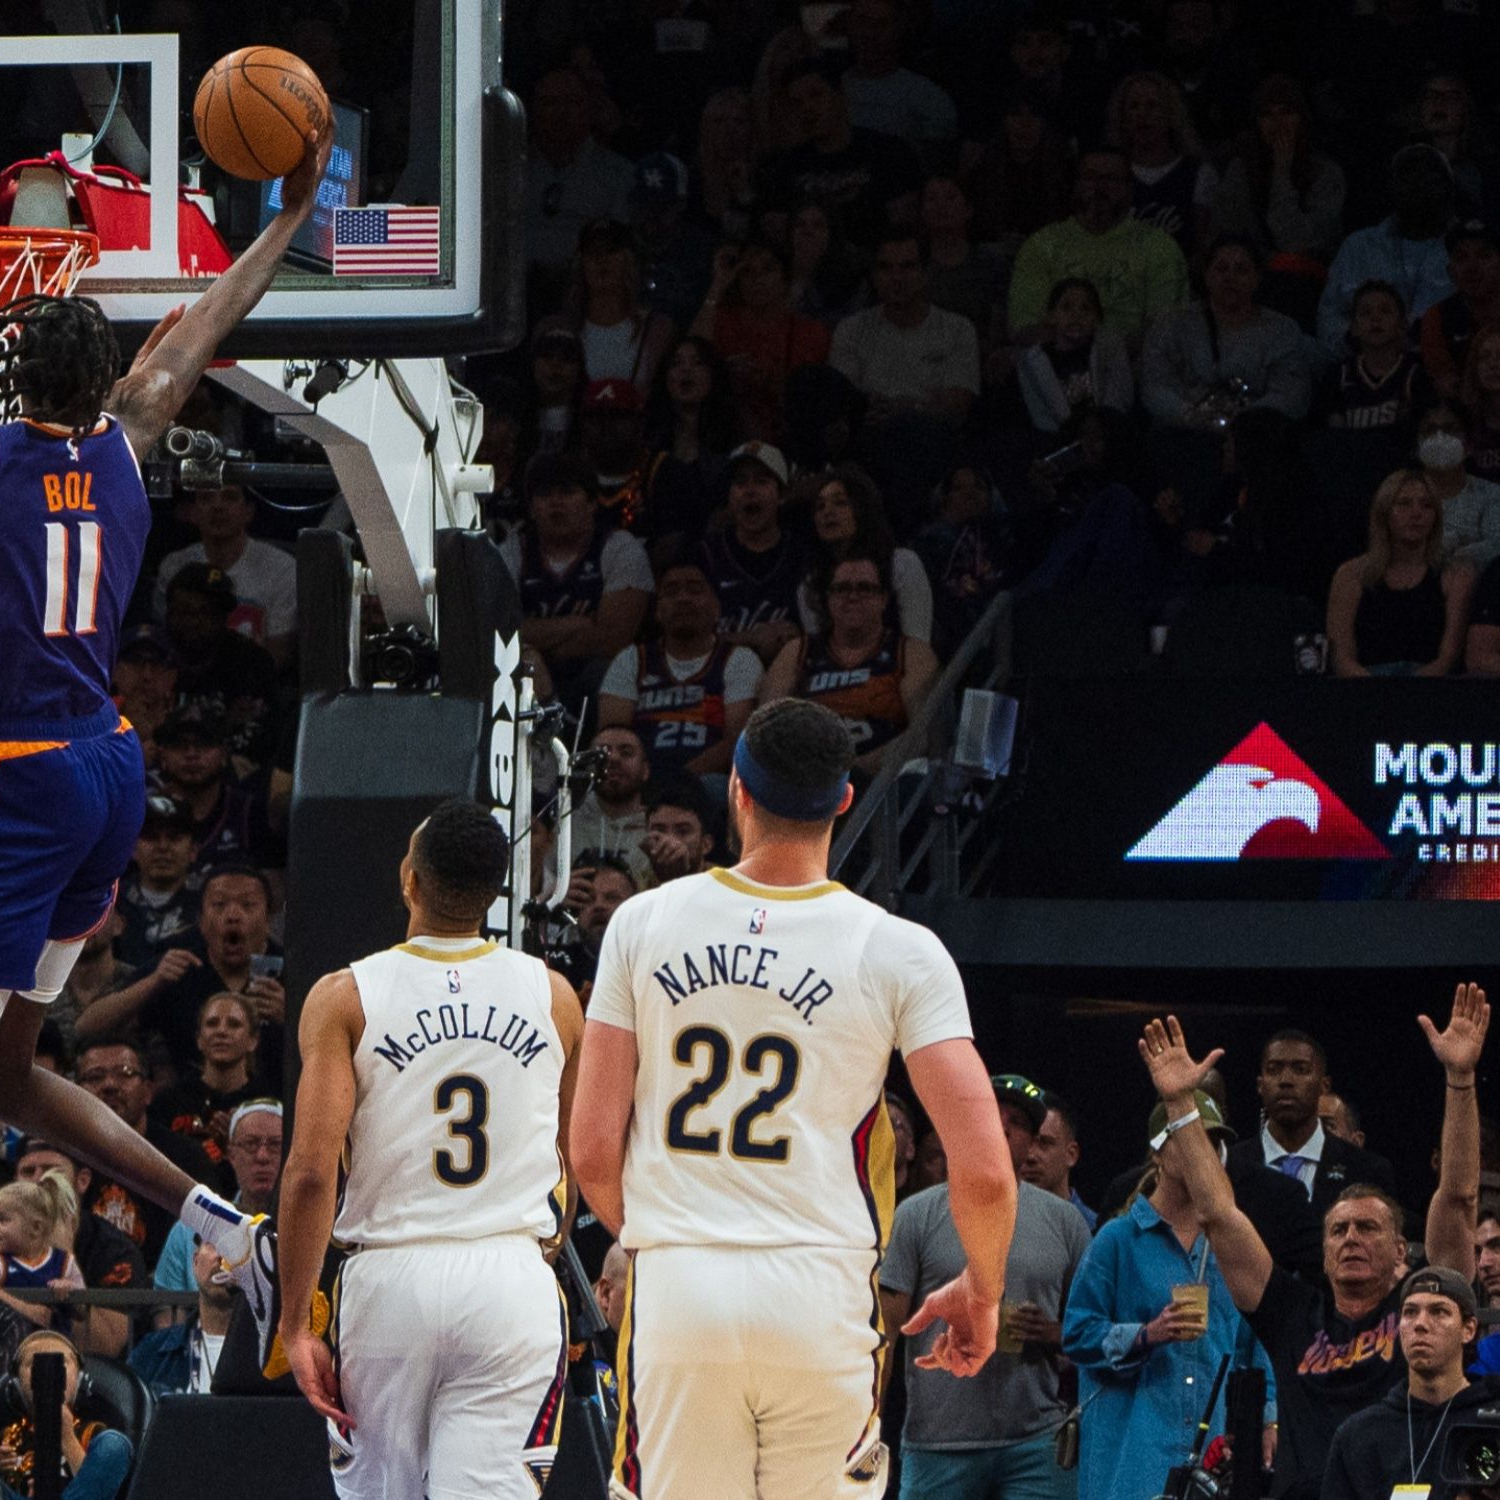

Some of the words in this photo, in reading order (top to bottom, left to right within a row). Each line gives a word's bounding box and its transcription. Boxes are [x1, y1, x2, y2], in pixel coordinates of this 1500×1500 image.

[43, 471, 97, 513] BOL
[43, 521, 103, 637] 11
[654, 719, 708, 749] 25
[1375, 742, 1500, 785] MOU
[653, 943, 778, 1006] NANCE
[779, 967, 834, 1027] JR.
[374, 1003, 549, 1073] McCOLLUM
[432, 1071, 491, 1189] 3
[665, 1023, 800, 1163] 22
